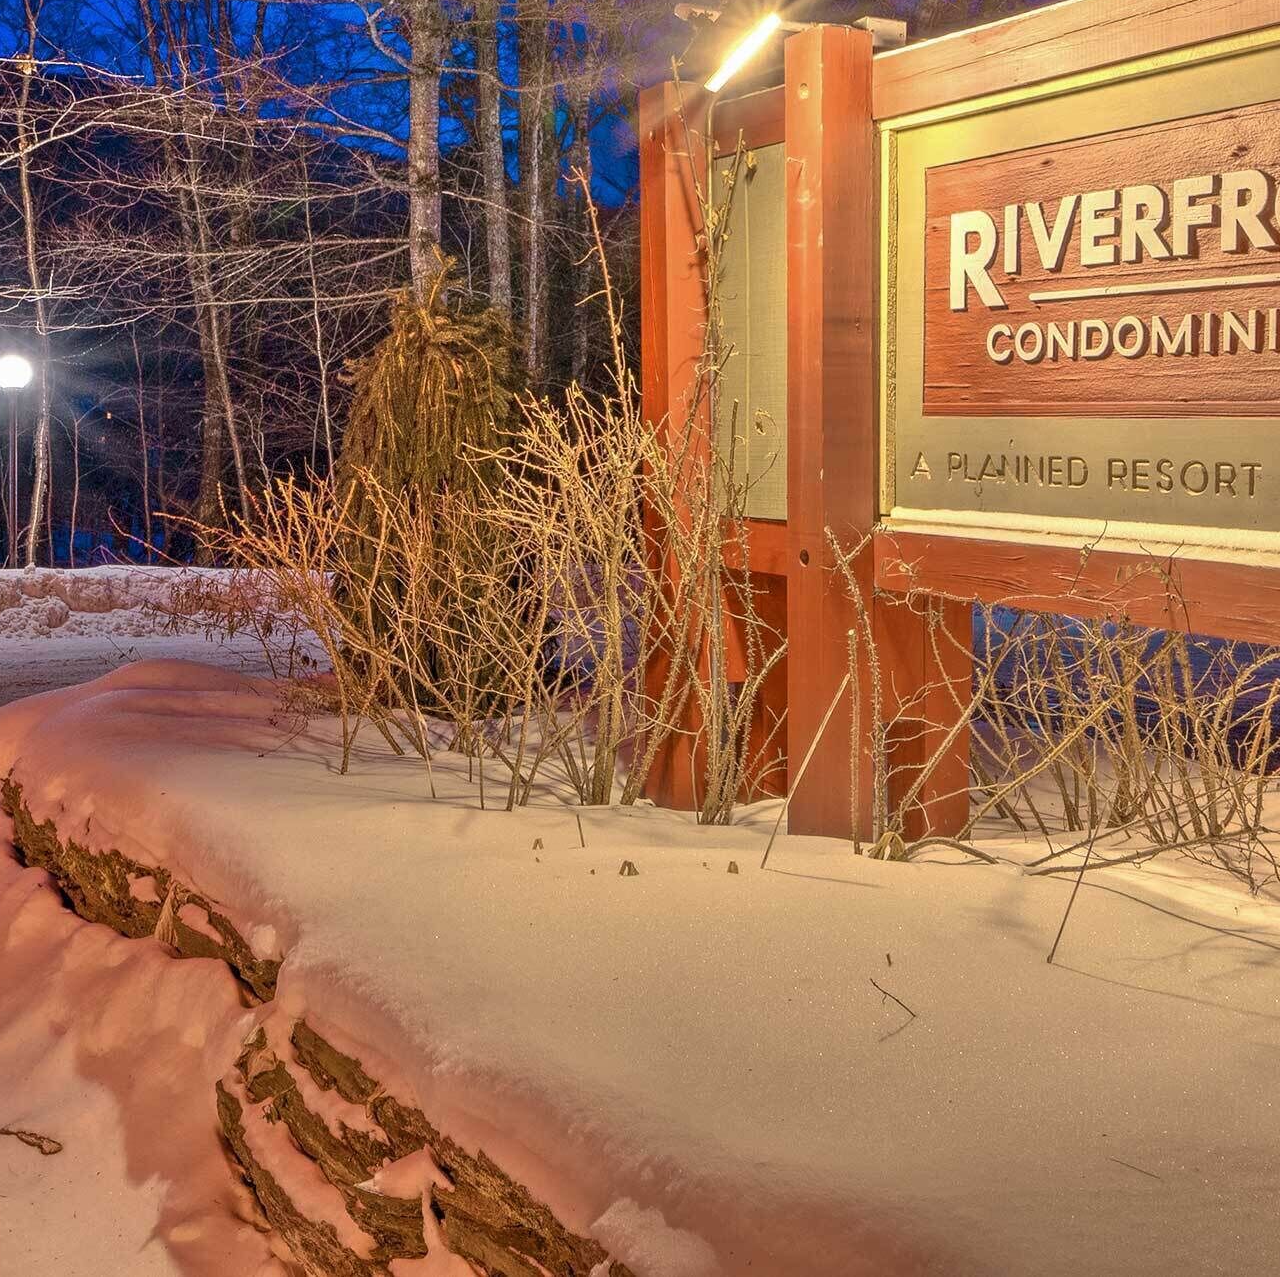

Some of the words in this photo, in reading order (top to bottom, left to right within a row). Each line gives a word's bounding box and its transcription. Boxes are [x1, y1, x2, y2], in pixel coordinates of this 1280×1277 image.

[910, 452, 931, 481] A
[947, 453, 1090, 488] PLANNED
[1107, 458, 1264, 499] RESORT
